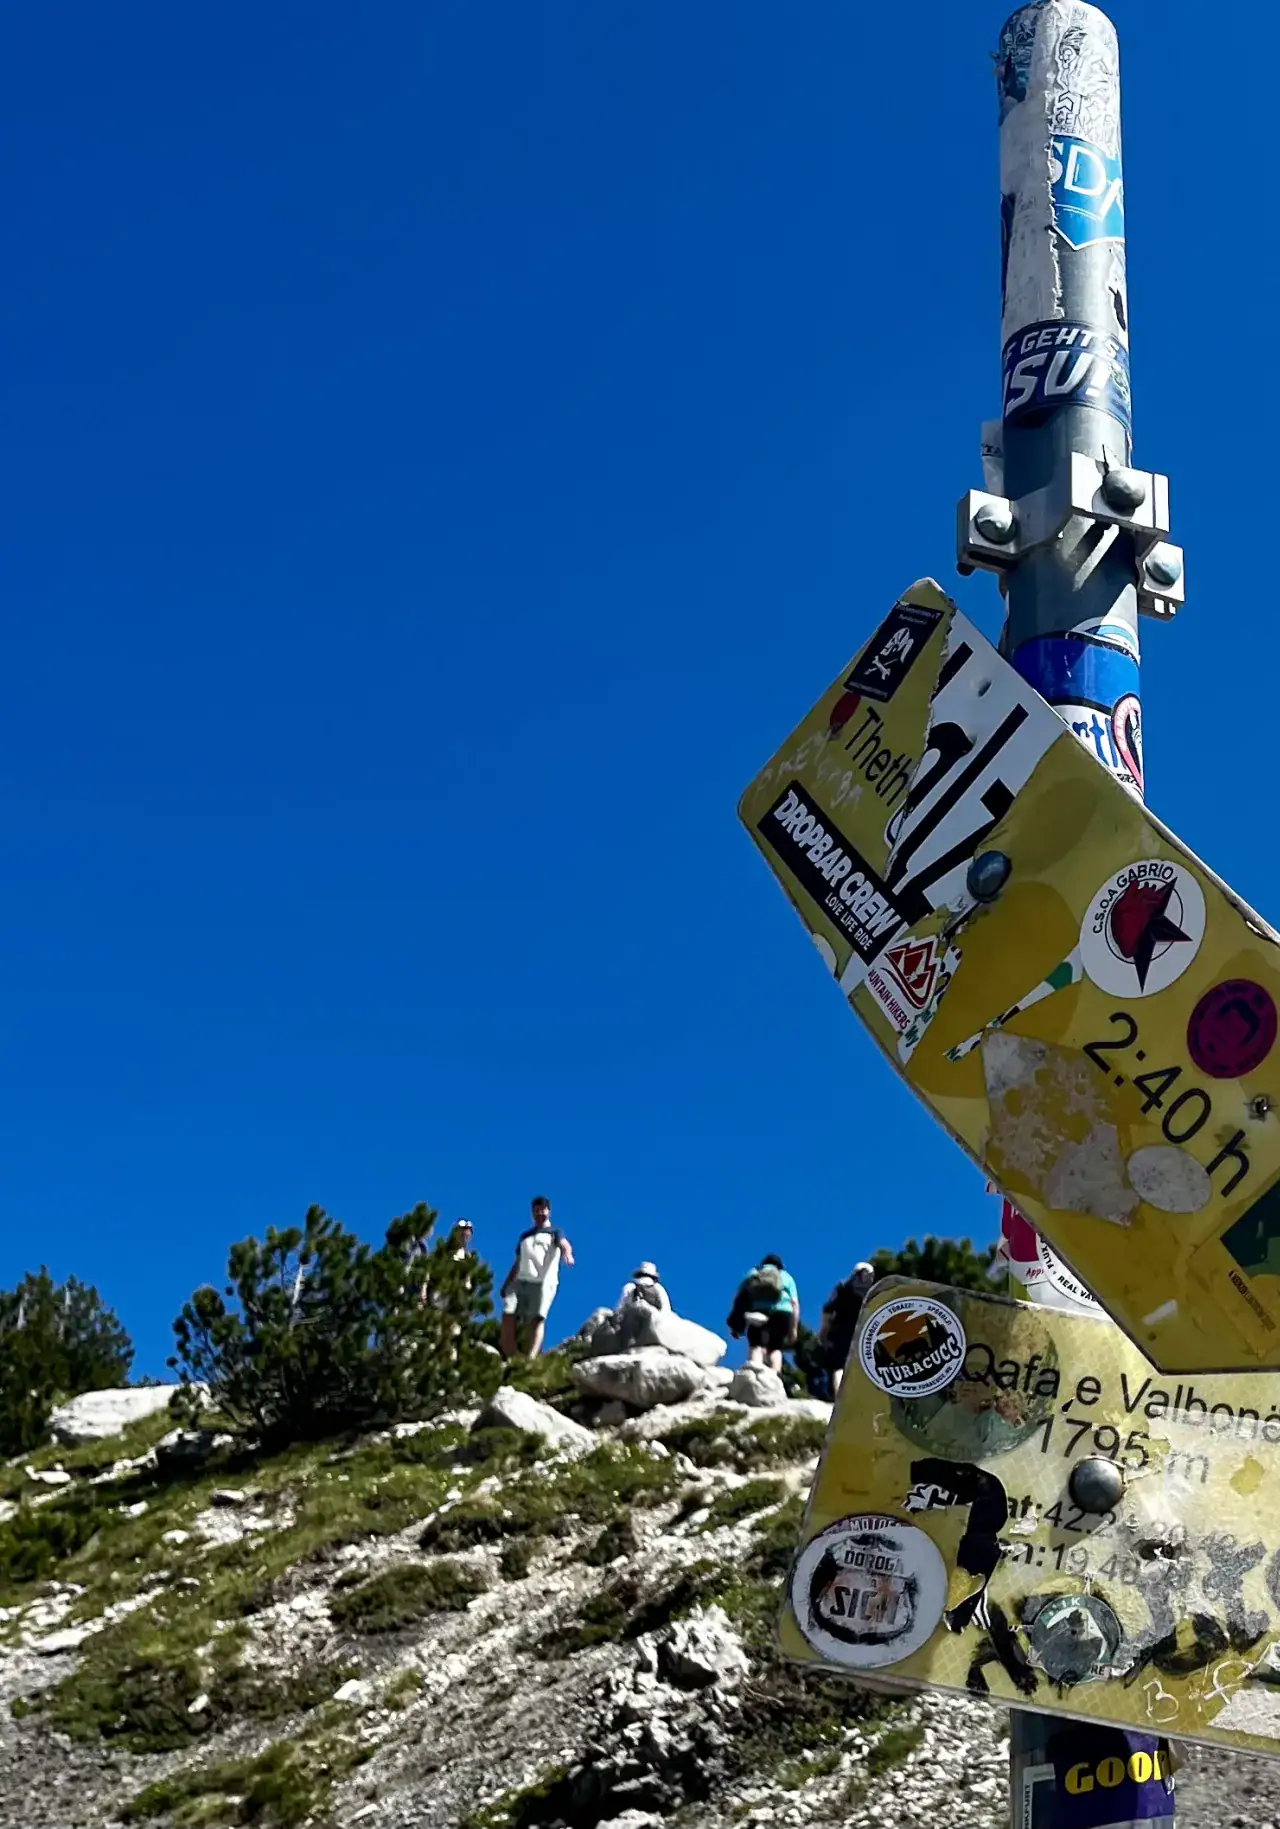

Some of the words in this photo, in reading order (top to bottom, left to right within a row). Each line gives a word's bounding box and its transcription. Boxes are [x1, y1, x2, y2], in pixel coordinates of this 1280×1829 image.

[845, 705, 912, 807] Theth
[773, 789, 852, 887] DROPBAR
[839, 871, 902, 938] CREW
[1116, 862, 1174, 888] GABRIO
[825, 892, 845, 917] LOVE
[840, 912, 859, 933] LIFE
[853, 927, 873, 951] RIDE
[887, 997, 911, 1030] HIKERS
[1203, 1129, 1251, 1198] h
[1057, 1275, 1078, 1294] REAL
[963, 1343, 1061, 1400] Qafa
[1076, 1375, 1102, 1406] e
[1037, 1413, 1150, 1470] 1795
